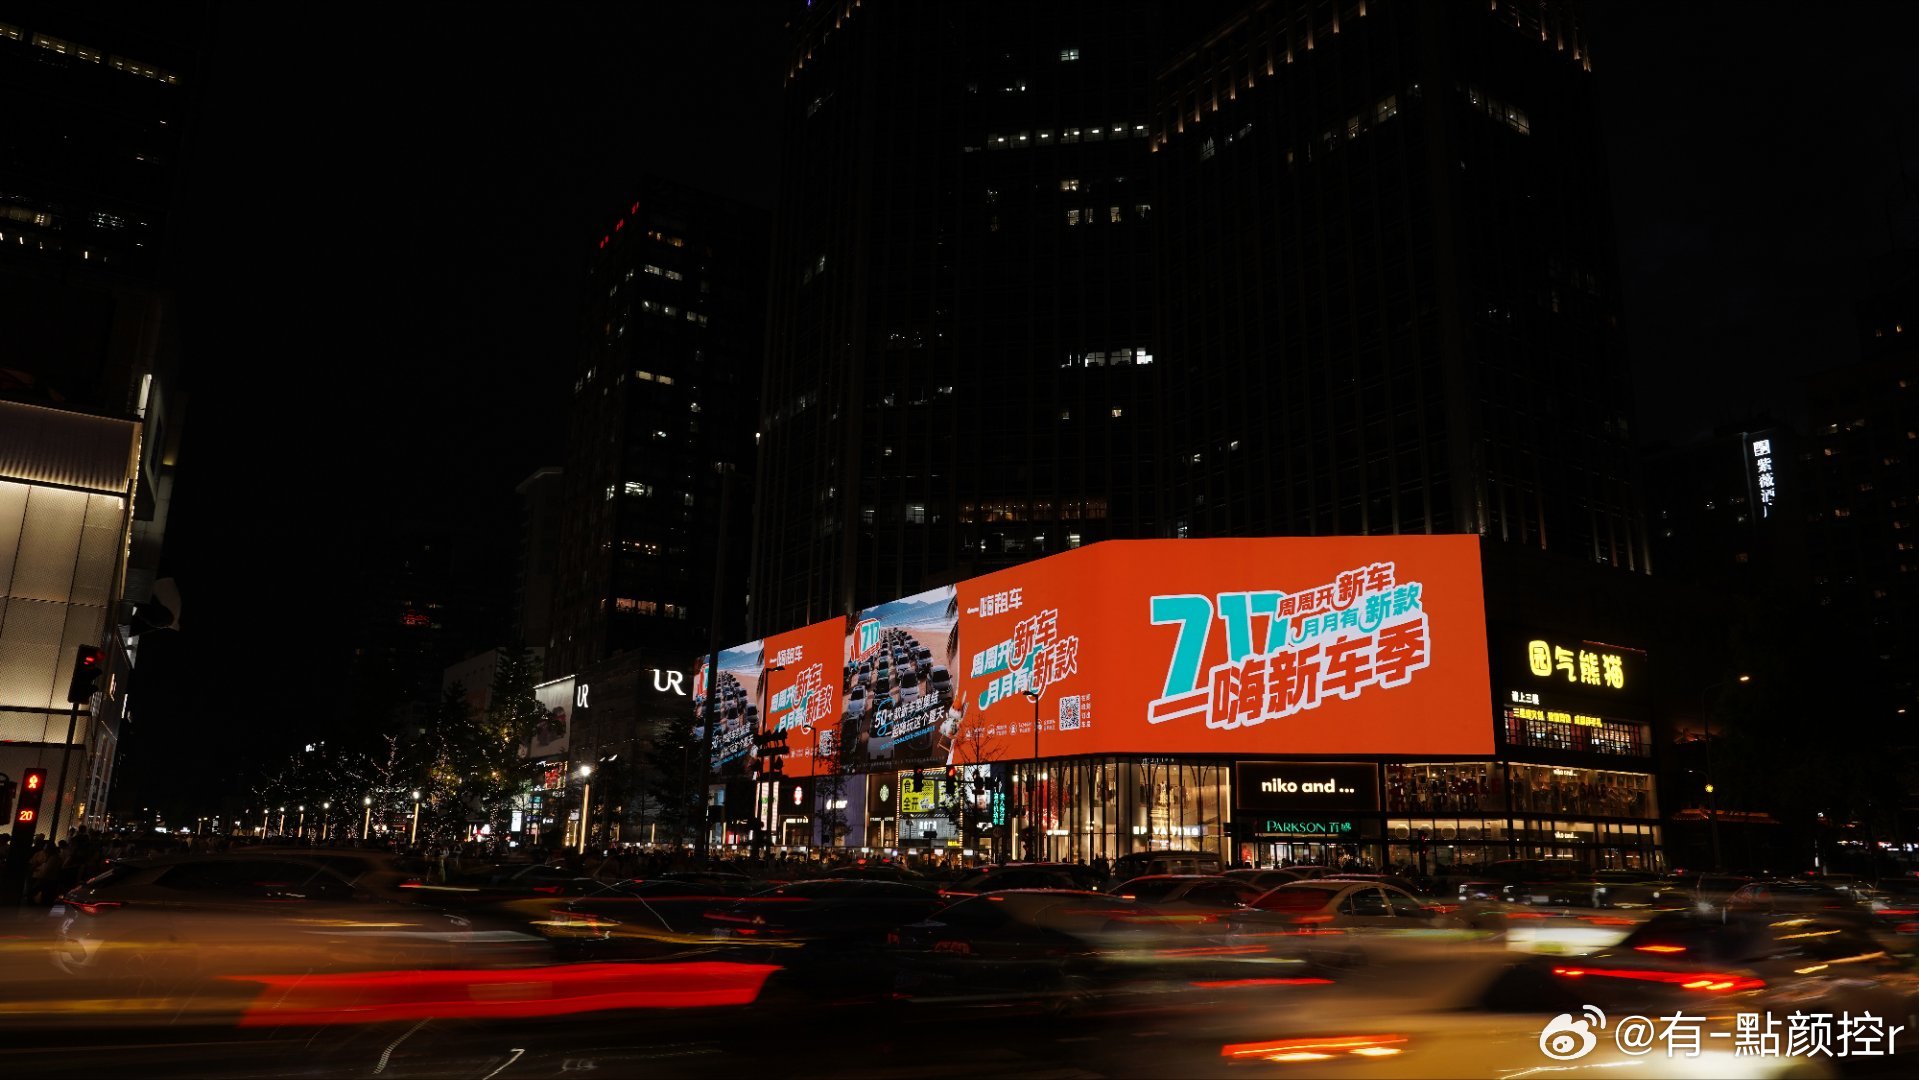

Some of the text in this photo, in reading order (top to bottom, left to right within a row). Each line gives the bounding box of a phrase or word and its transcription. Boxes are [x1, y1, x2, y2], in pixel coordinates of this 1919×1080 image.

[966, 587, 1023, 618] 一嗨租车
[1277, 561, 1394, 618] 周周开新车
[1291, 583, 1421, 643] 月月有新款
[971, 608, 1058, 678] 周周开新车
[1151, 591, 1291, 697] 717
[577, 684, 589, 708] UR
[653, 669, 686, 696] UR
[770, 663, 823, 712] 周周开新车
[979, 635, 1079, 711] 月月有新款
[1149, 614, 1429, 729] 一嗨新车季
[775, 684, 834, 734] 月月有新款
[1262, 778, 1298, 793] niko
[1302, 778, 1335, 793] and
[19, 810, 34, 821] 20
[1266, 821, 1326, 833] PARKSON
